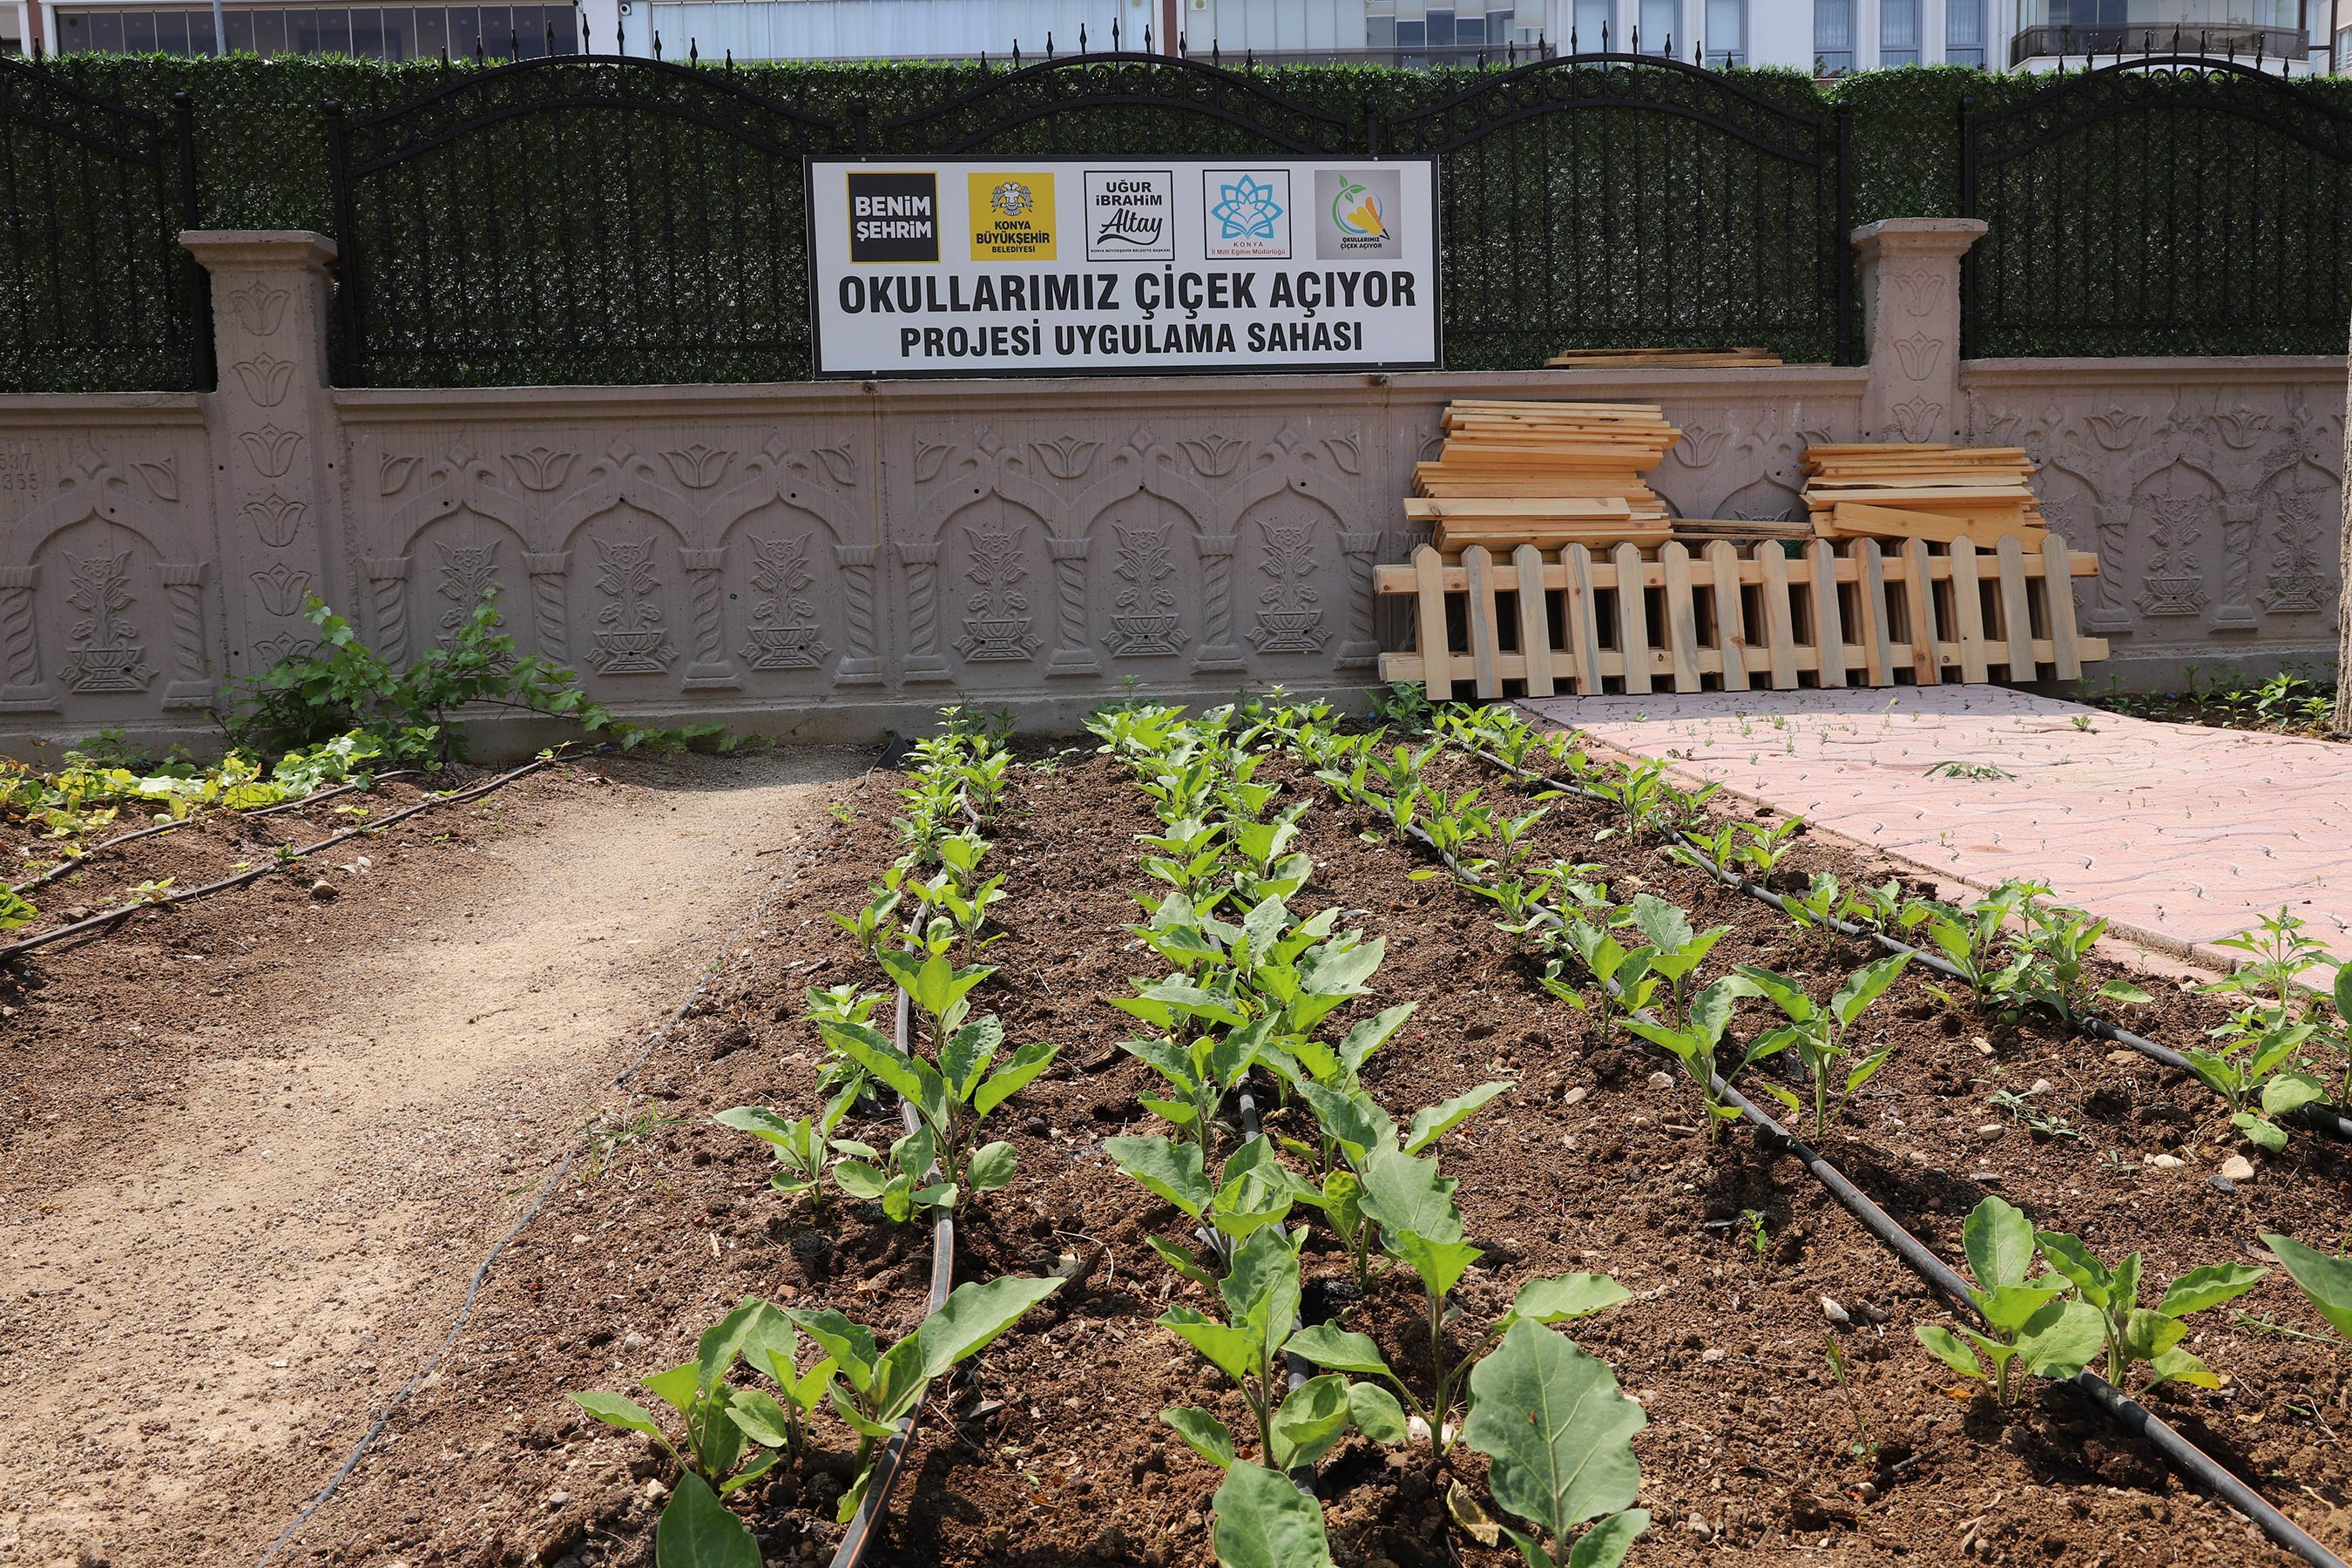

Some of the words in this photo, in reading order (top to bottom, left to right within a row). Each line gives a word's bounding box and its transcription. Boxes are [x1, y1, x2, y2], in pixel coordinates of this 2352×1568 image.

[1105, 179, 1152, 193] UĞUR
[855, 195, 931, 217] BENİM
[856, 220, 932, 241] ŞEHRİM
[995, 220, 1031, 230] KONYA
[1097, 207, 1163, 246] Altay
[976, 231, 1050, 246] BÜYÜKŞEHİR
[839, 274, 1119, 314] OKULLARIMIZ
[1134, 264, 1257, 320] ÇİÇEK
[1269, 270, 1416, 318] AÇIYOR
[900, 318, 1041, 357] PROJESİ
[1054, 323, 1236, 355] UYGULAMA
[1247, 321, 1362, 352] SAHASI
